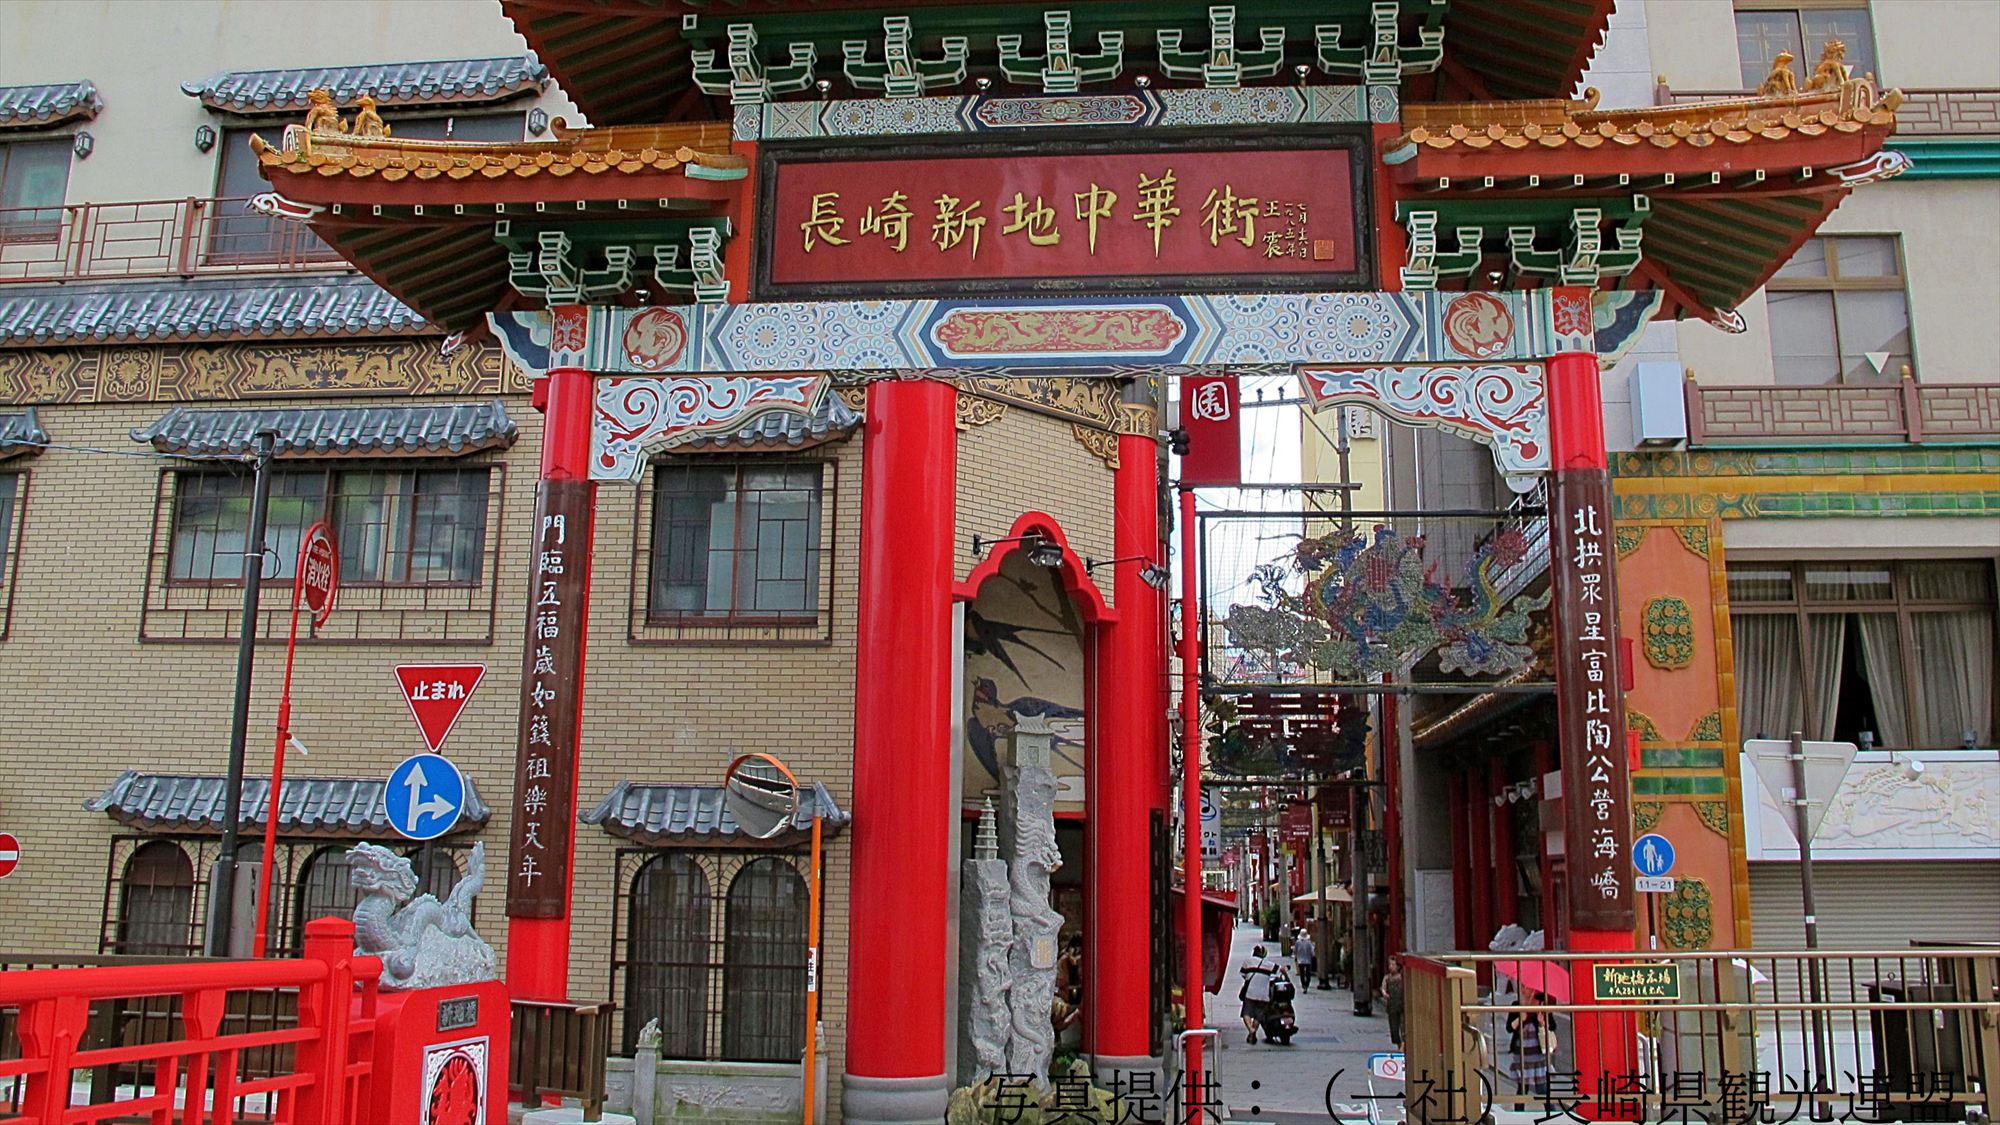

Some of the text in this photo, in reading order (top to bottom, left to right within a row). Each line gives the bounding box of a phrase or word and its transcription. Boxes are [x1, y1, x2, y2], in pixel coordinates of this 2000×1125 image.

[799, 168, 1260, 262] 長崎新地中華街
[306, 556, 331, 593] 消火栓
[410, 681, 466, 701] 止まれ
[1637, 880, 1673, 890] 11-21
